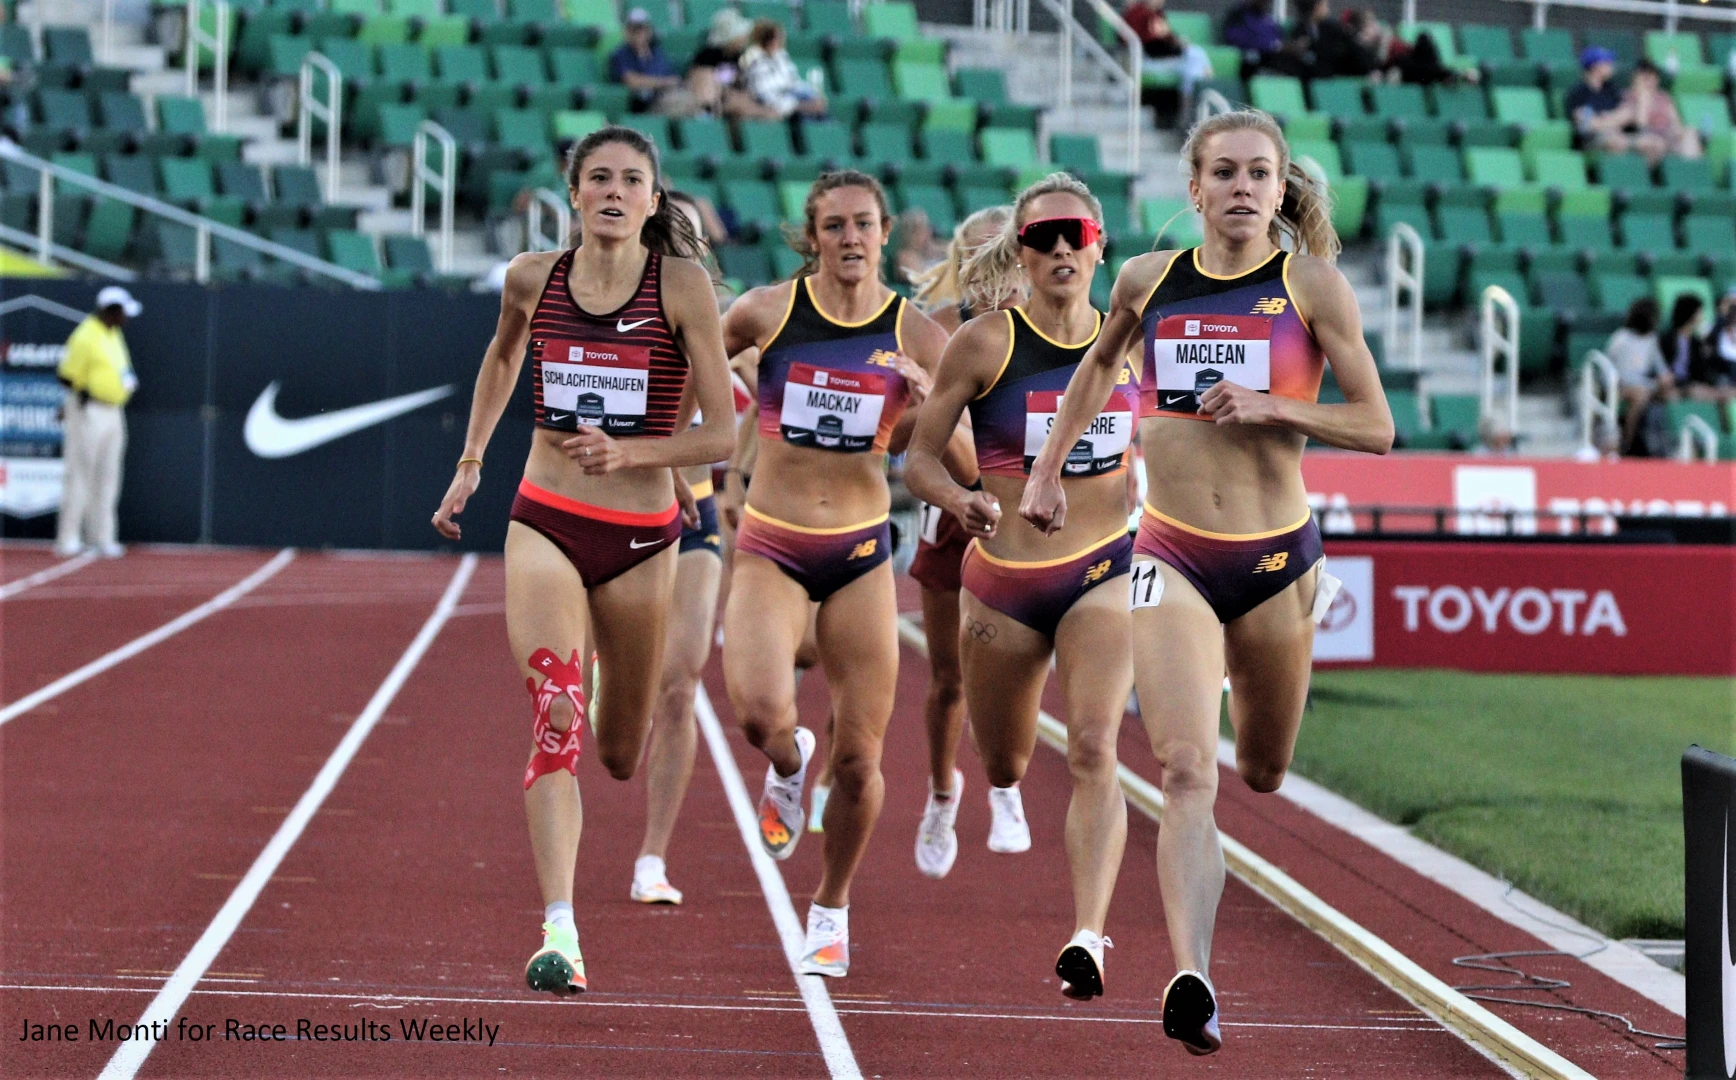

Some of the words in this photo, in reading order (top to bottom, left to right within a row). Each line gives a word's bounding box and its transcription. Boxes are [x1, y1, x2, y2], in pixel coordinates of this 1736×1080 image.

[1202, 324, 1239, 333] TOYOTA
[585, 351, 619, 361] TOYOTA
[1175, 343, 1245, 364] MACLEAN
[544, 370, 644, 392] SCHLACHTENHAUFEN
[829, 376, 861, 388] TOYOTA
[806, 390, 862, 414] MACKAY
[1131, 565, 1157, 606] 11
[1394, 584, 1628, 637] TOYOTA
